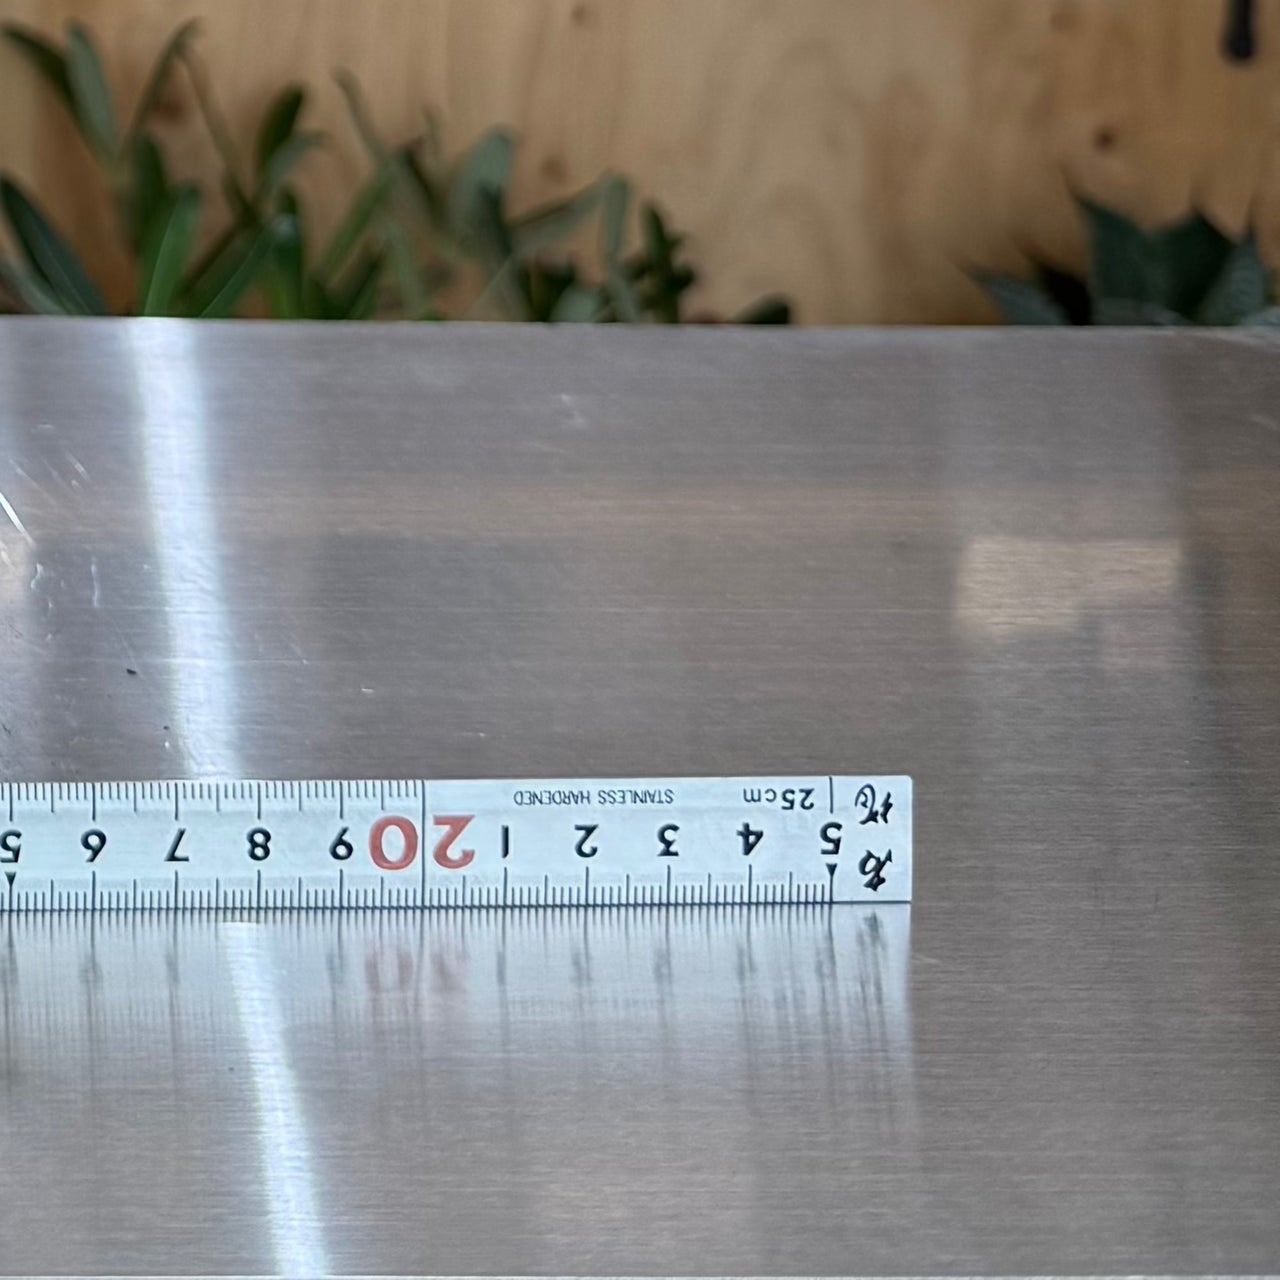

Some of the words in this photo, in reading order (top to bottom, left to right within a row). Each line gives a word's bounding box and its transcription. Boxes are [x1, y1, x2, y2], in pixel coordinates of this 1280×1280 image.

[513, 789, 591, 806] HARDENED
[597, 789, 675, 805] STAINLESS
[0, 830, 23, 864] 5
[80, 829, 108, 863] 6
[164, 828, 191, 862] 7
[246, 827, 272, 862] 8
[329, 827, 354, 861] 9
[368, 813, 476, 871] 20
[501, 824, 510, 860] 1
[573, 823, 599, 859] 2
[656, 823, 681, 858] 3
[736, 821, 765, 857] 4
[819, 821, 843, 856] 5
